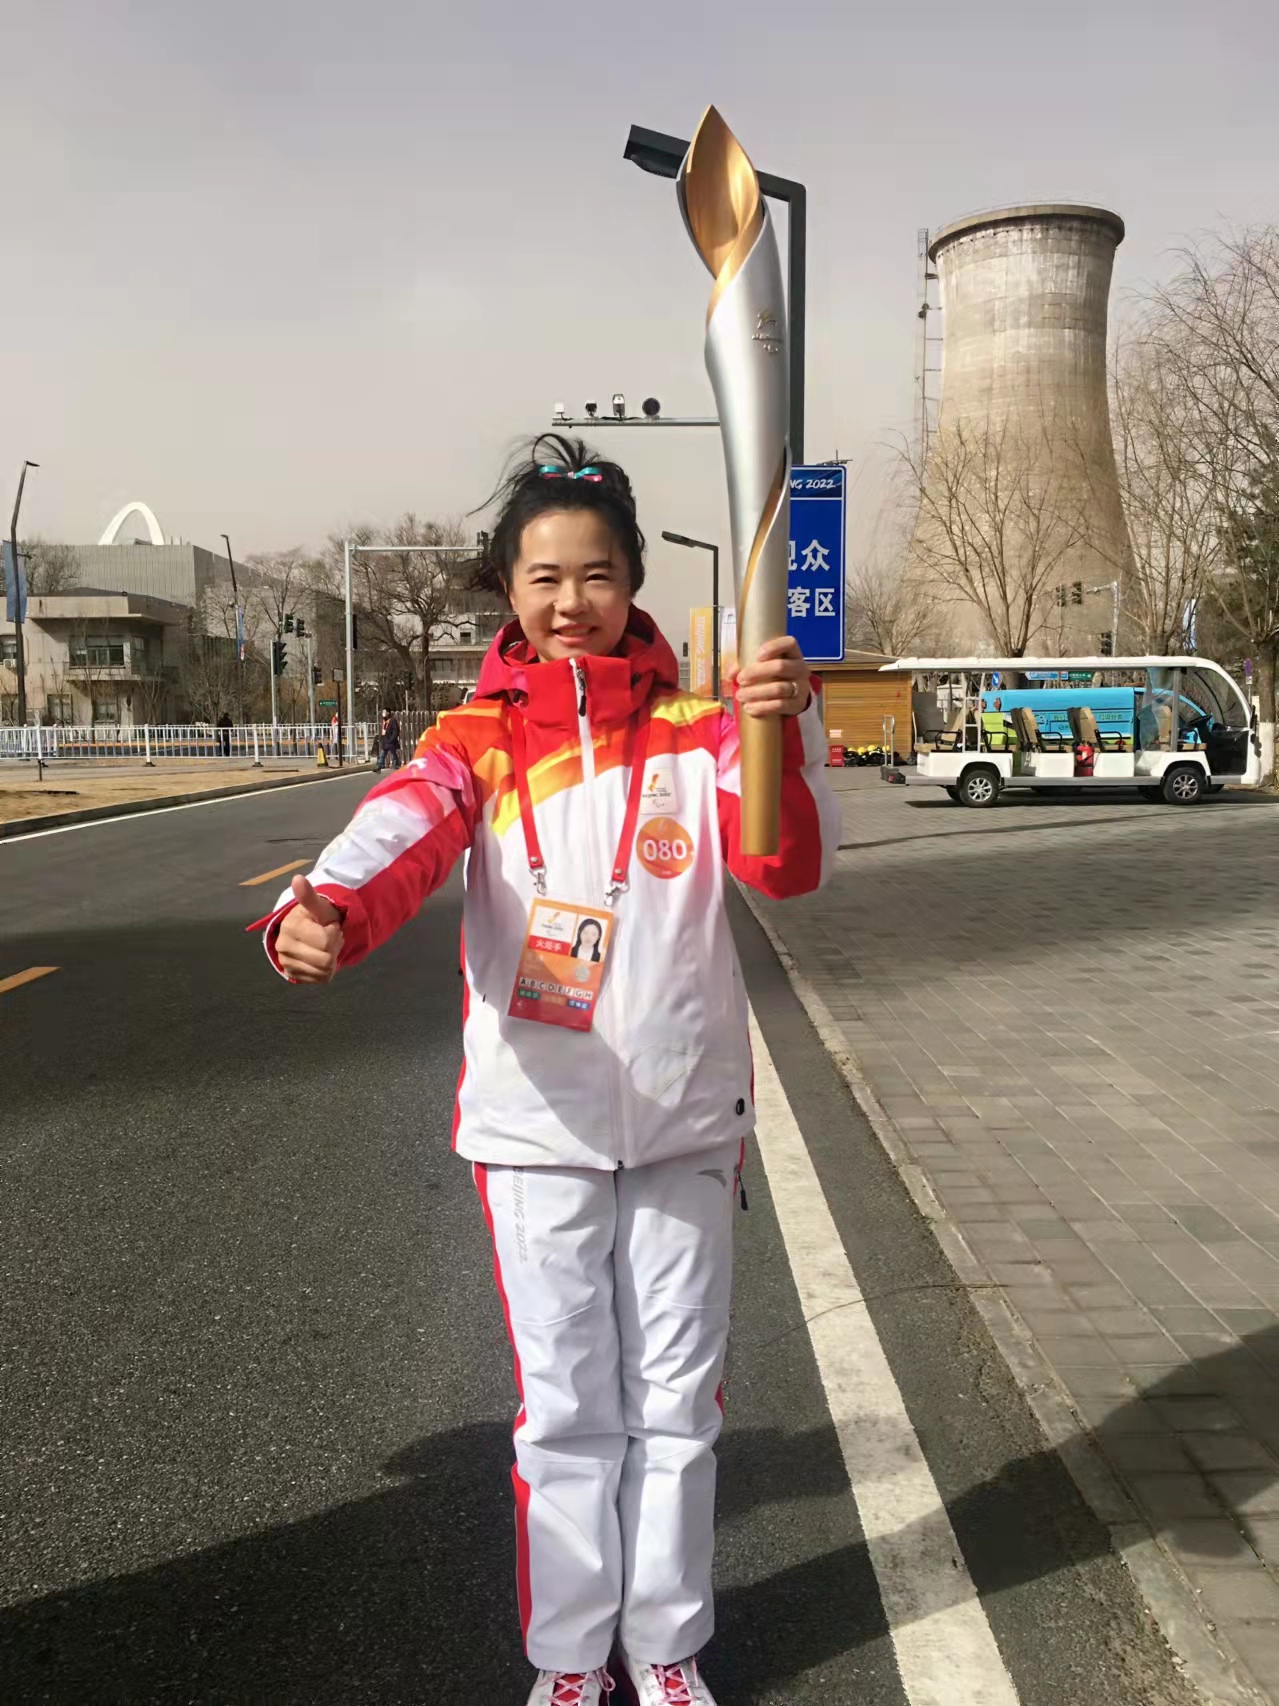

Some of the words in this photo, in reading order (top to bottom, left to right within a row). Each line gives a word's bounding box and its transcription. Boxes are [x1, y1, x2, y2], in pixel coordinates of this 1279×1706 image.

[805, 479, 836, 489] 2022
[787, 586, 836, 618] 客区
[643, 839, 687, 861] 080
